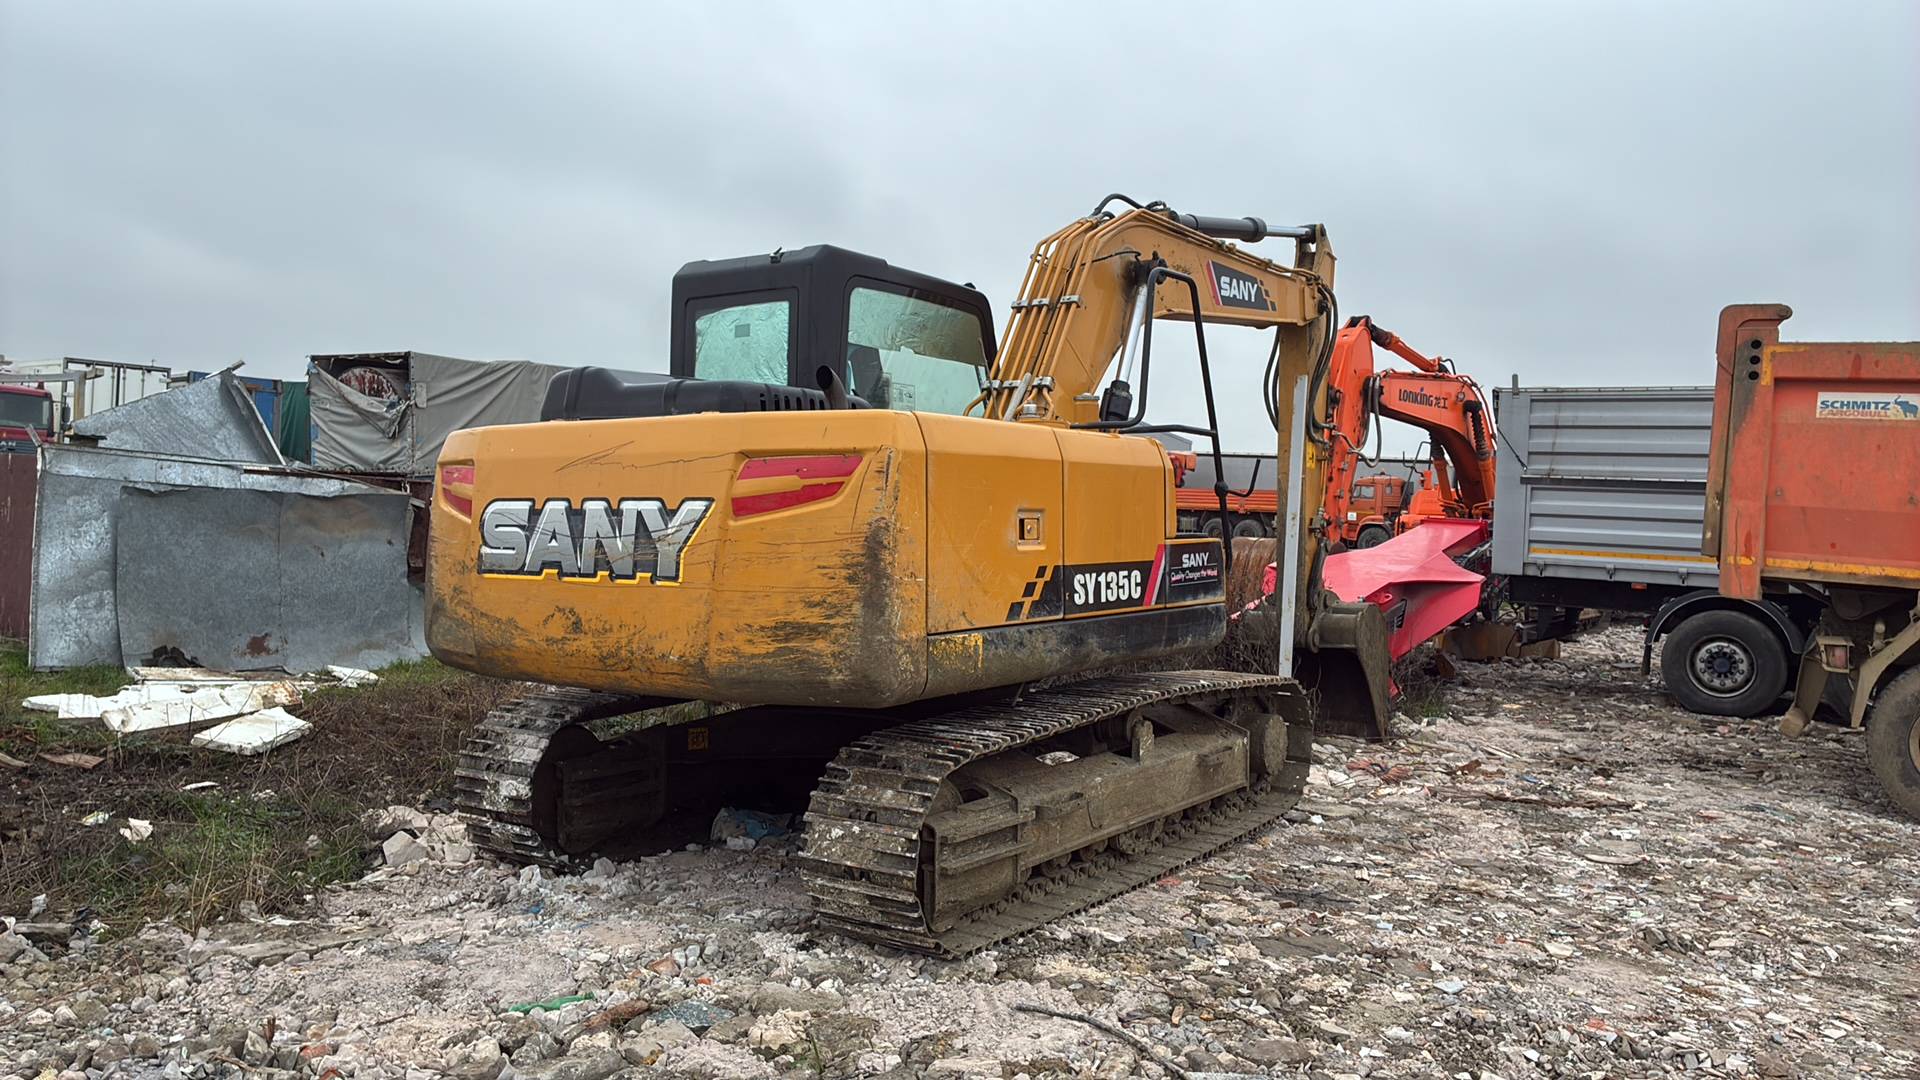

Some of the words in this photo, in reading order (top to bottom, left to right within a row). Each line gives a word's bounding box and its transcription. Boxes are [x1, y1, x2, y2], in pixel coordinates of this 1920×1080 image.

[1220, 275, 1258, 303] SANY
[1820, 400, 1891, 411] SCHMITZ
[479, 498, 711, 582] SANY
[1182, 552, 1209, 568] SANY
[1073, 570, 1142, 606] SY135C
